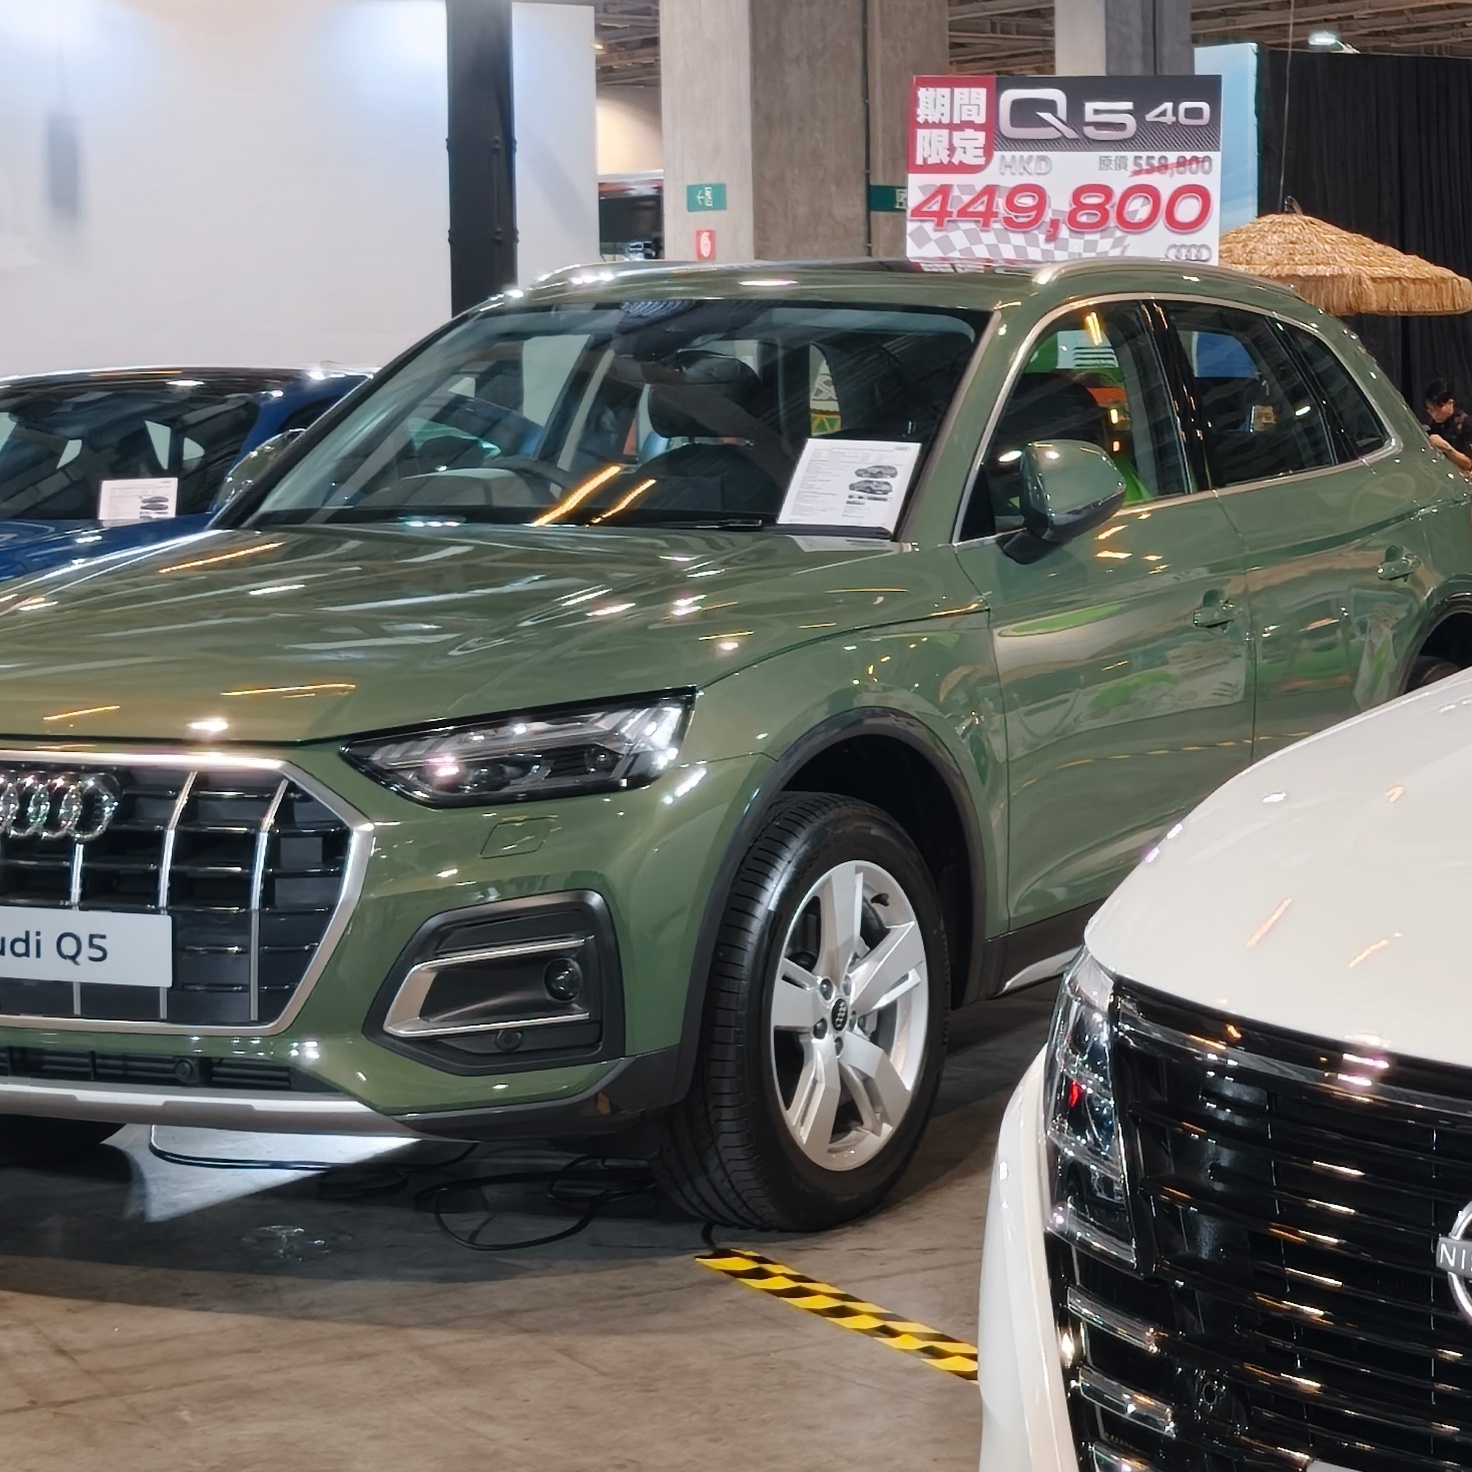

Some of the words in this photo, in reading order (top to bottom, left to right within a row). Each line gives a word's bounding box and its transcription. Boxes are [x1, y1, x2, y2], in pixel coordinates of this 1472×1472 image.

[916, 87, 987, 125] 期間
[999, 88, 1137, 141] Q5
[1145, 101, 1210, 125] 40
[915, 128, 986, 165] 限定
[1000, 155, 1052, 176] HKD
[910, 183, 1212, 242] 449,800
[56, 932, 108, 964] Q5
